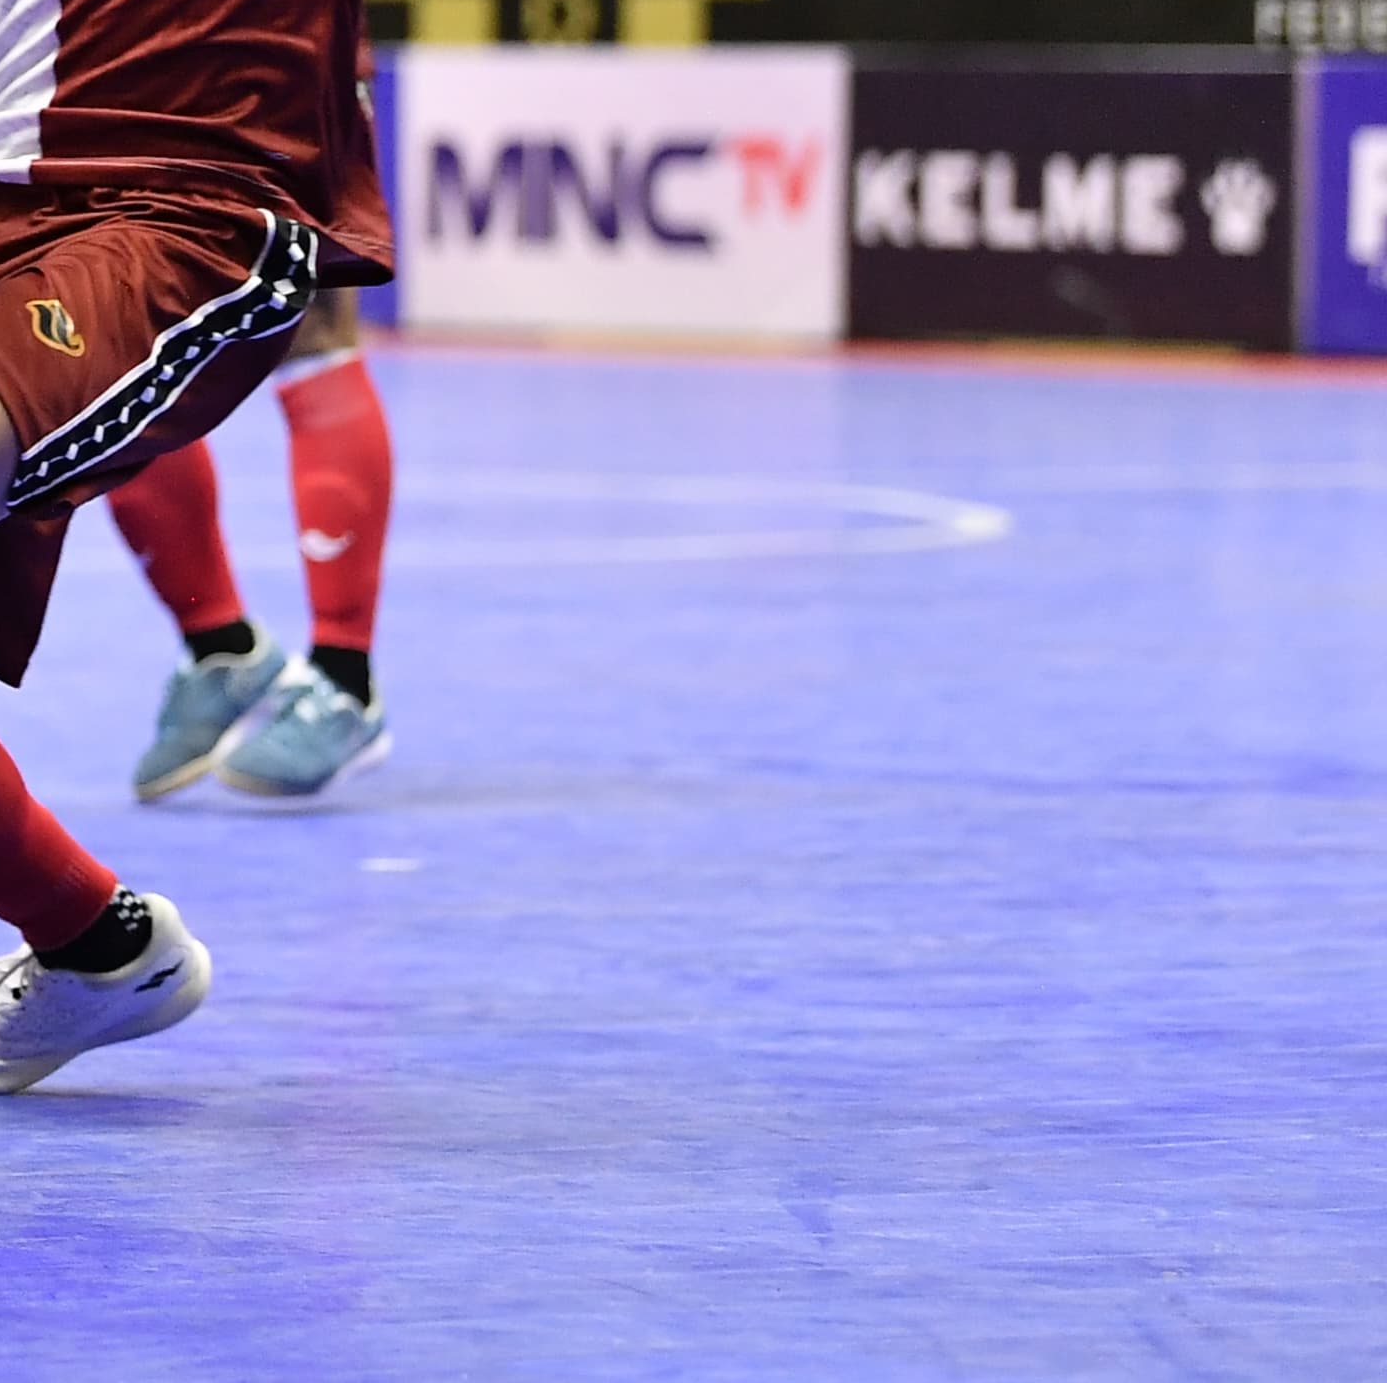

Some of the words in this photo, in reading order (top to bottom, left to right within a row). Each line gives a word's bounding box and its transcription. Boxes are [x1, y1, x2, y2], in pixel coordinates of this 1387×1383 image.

[425, 136, 717, 248] MNC
[727, 136, 821, 216] TV
[853, 148, 1187, 256] KELME
